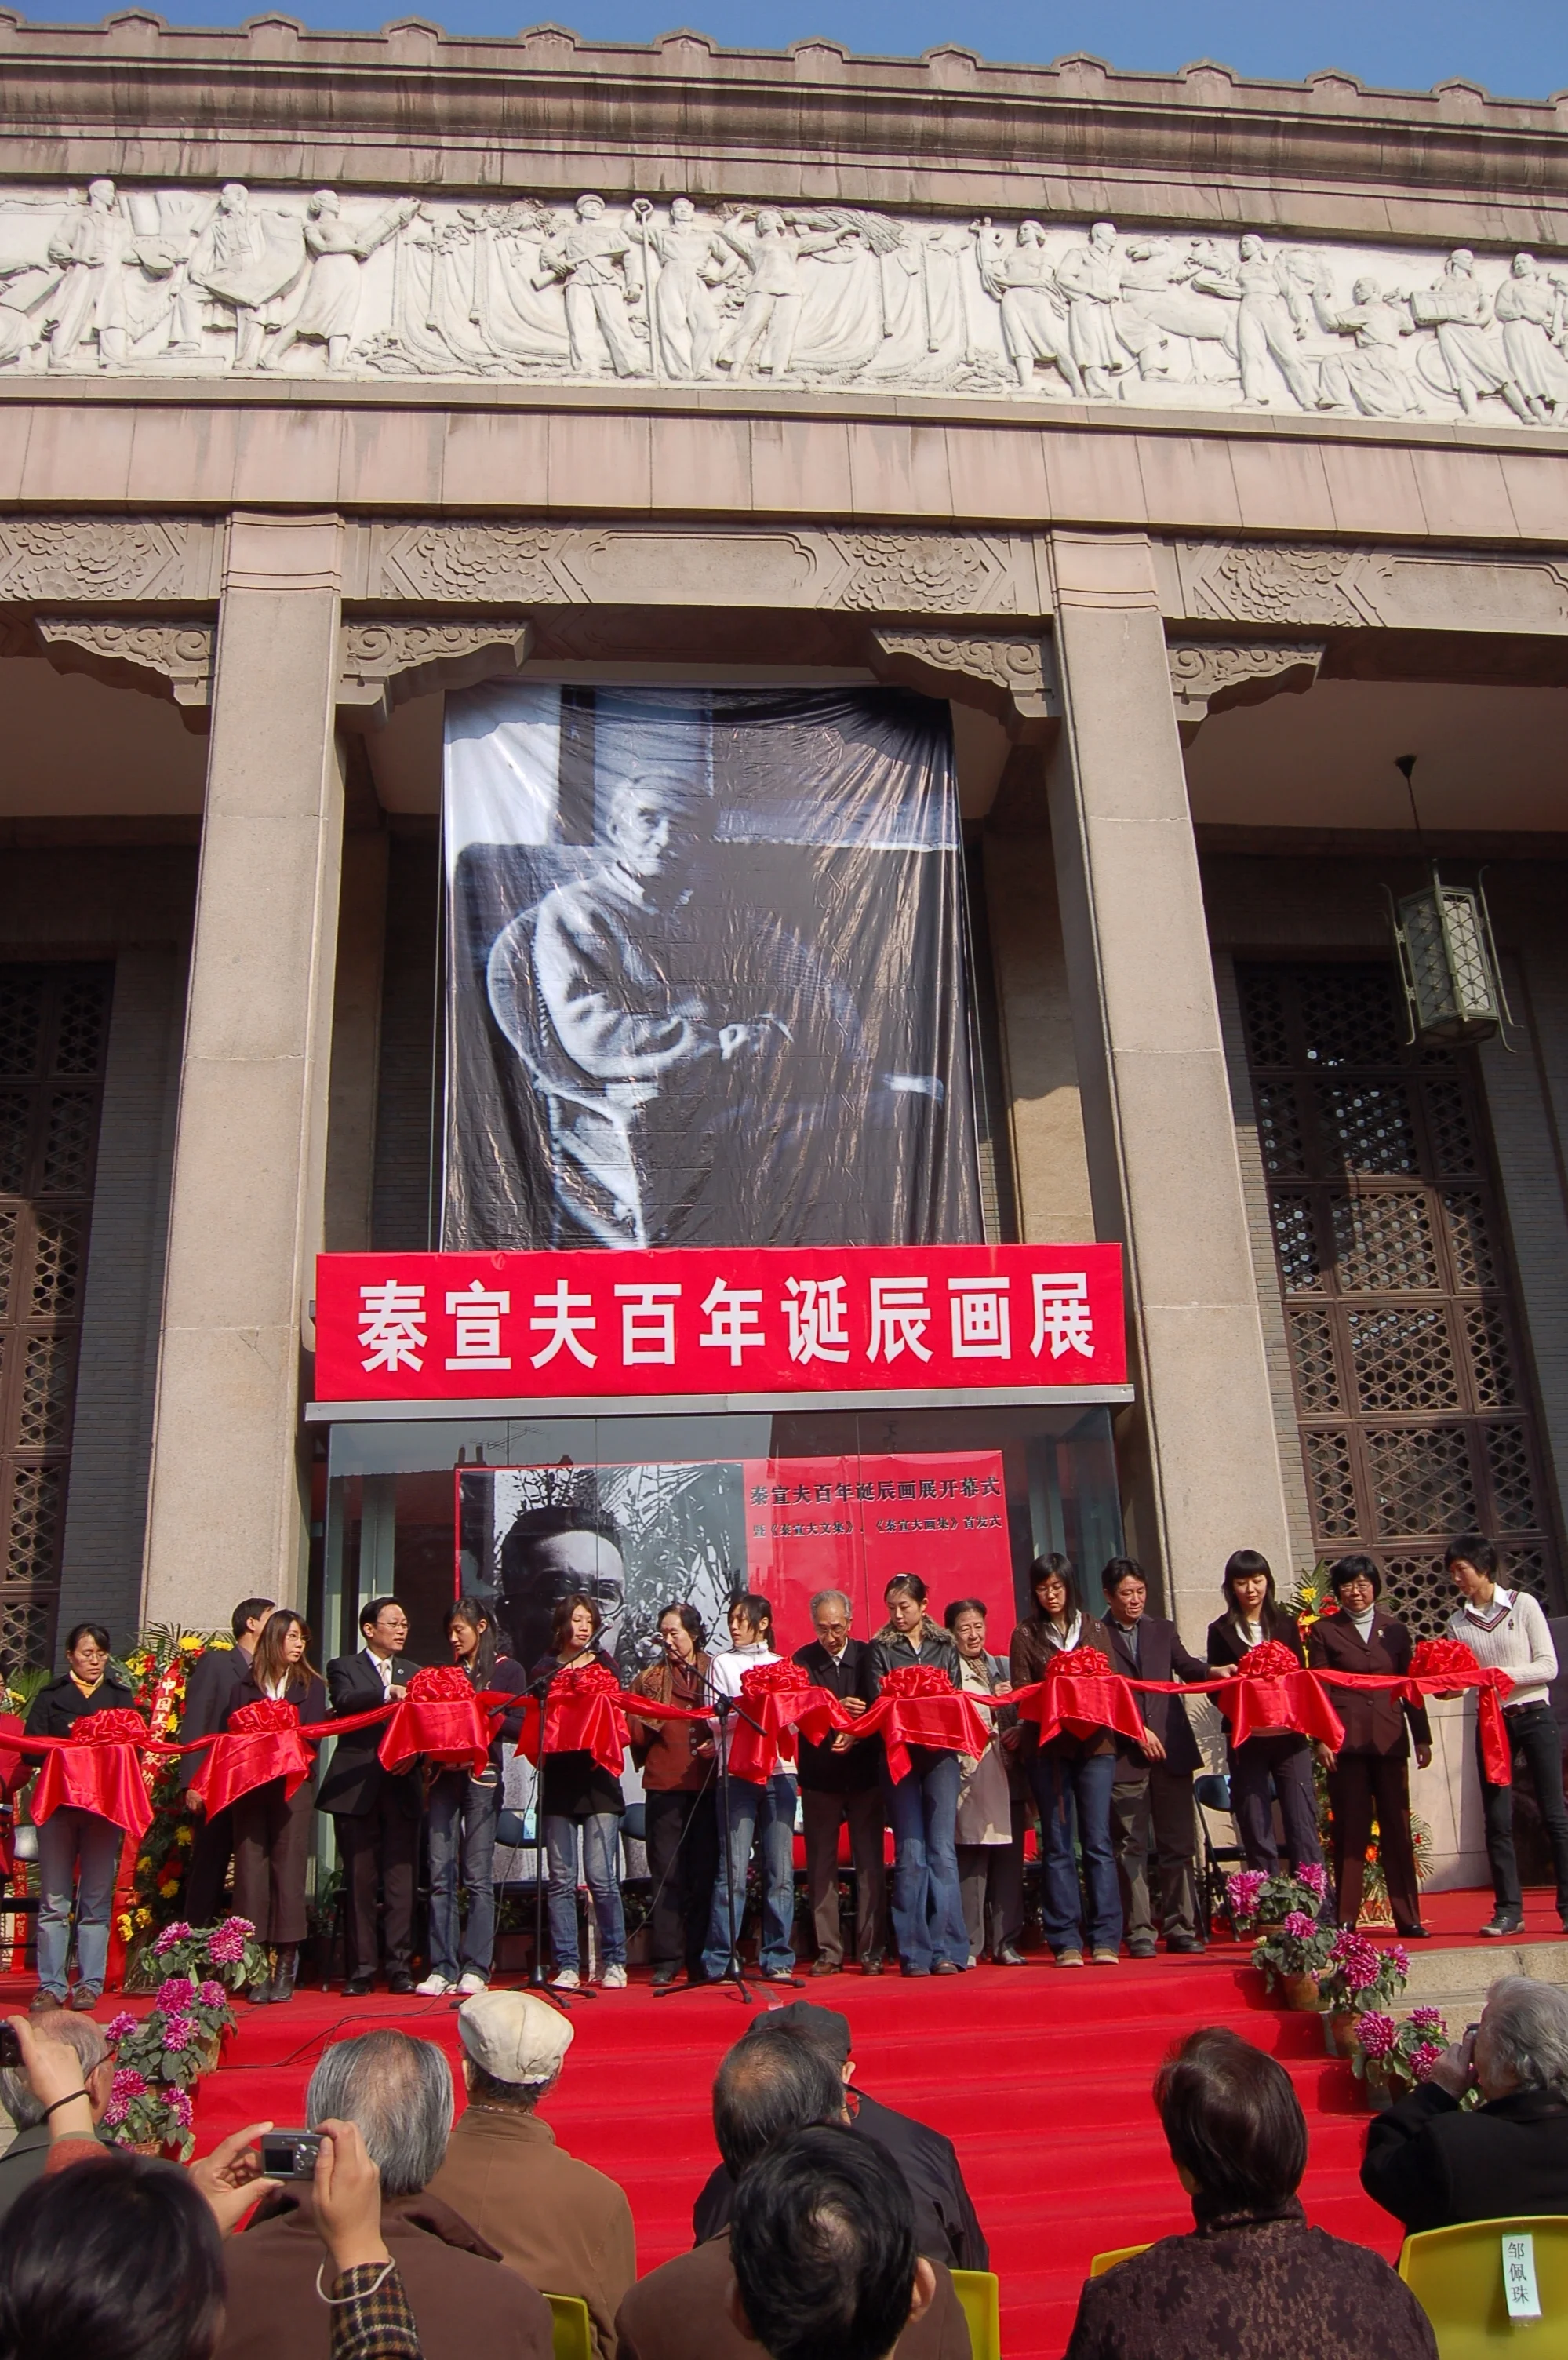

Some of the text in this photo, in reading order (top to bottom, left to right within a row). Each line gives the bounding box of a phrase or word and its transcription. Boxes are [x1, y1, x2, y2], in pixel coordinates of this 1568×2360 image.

[358, 1271, 1094, 1373] 秦宣夫百年诞辰画展
[750, 1477, 1002, 1506] 秦宣夫百年诞辰画展开幕式
[1508, 2242, 1530, 2304] 邹佩珠
